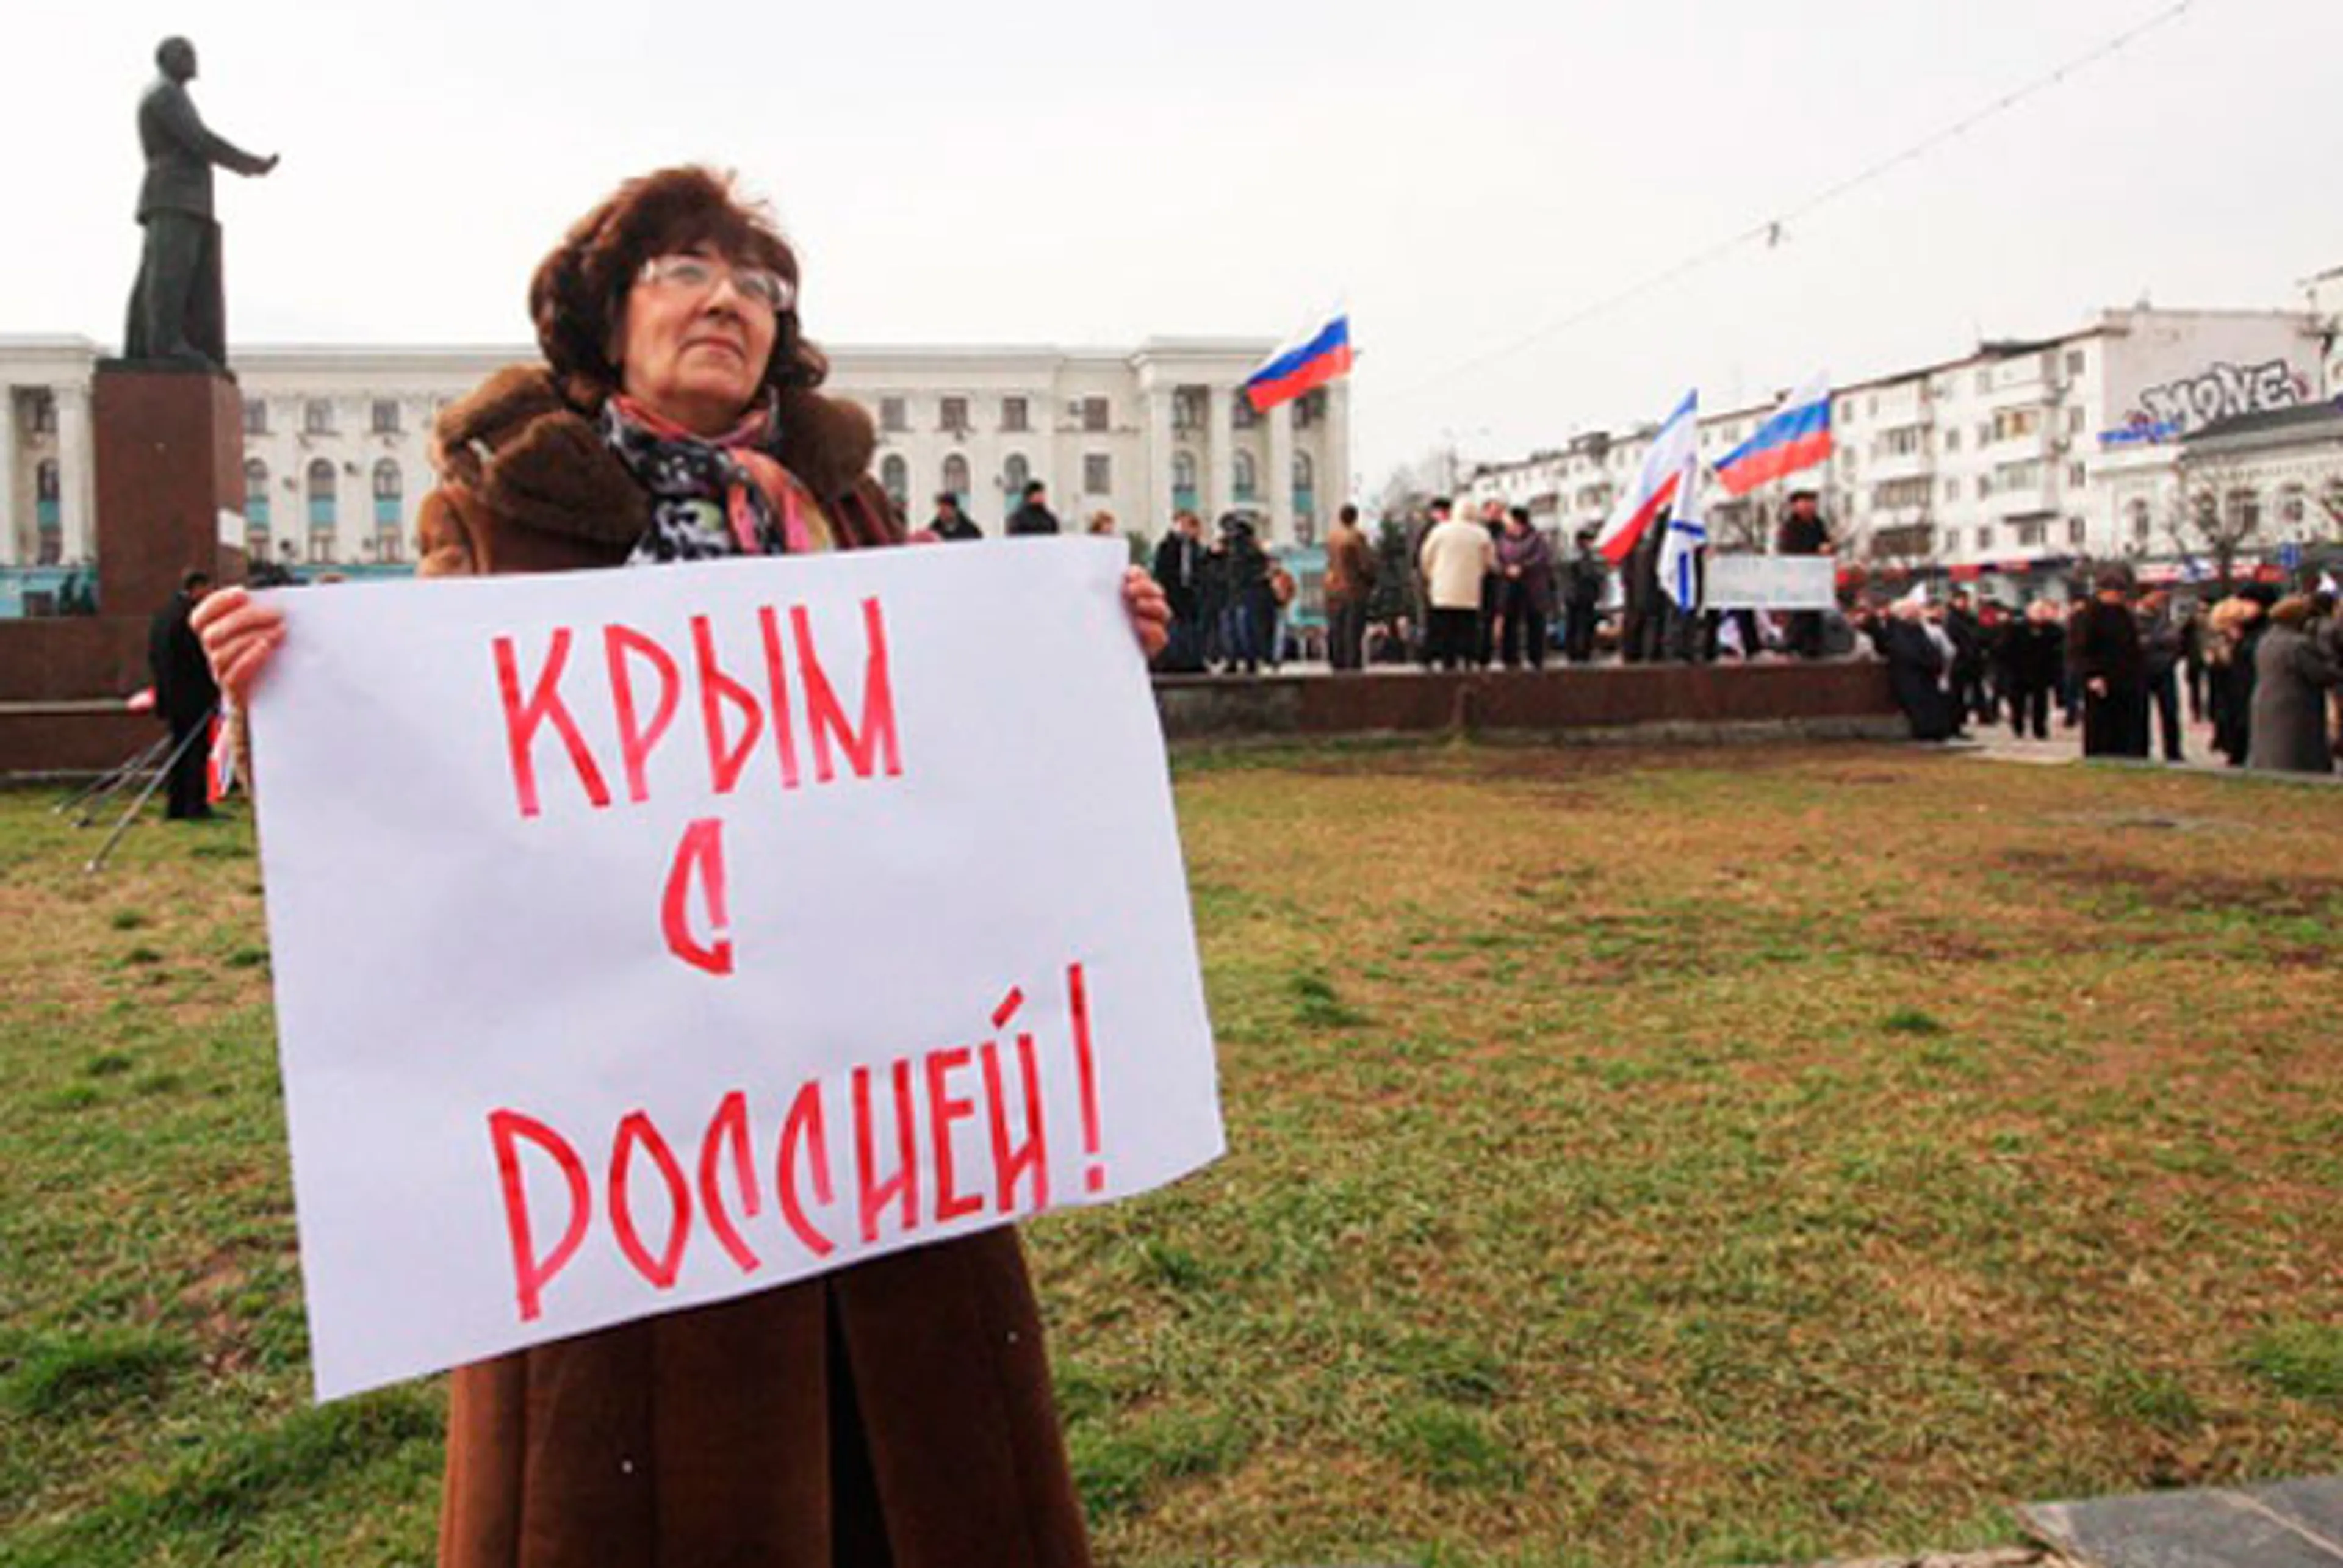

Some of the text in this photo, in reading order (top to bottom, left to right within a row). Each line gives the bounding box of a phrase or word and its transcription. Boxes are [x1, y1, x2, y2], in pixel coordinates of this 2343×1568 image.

[492, 597, 903, 819] КРЫМ
[660, 817, 735, 978] С
[487, 960, 1106, 1323] РОССИЕЙ!
